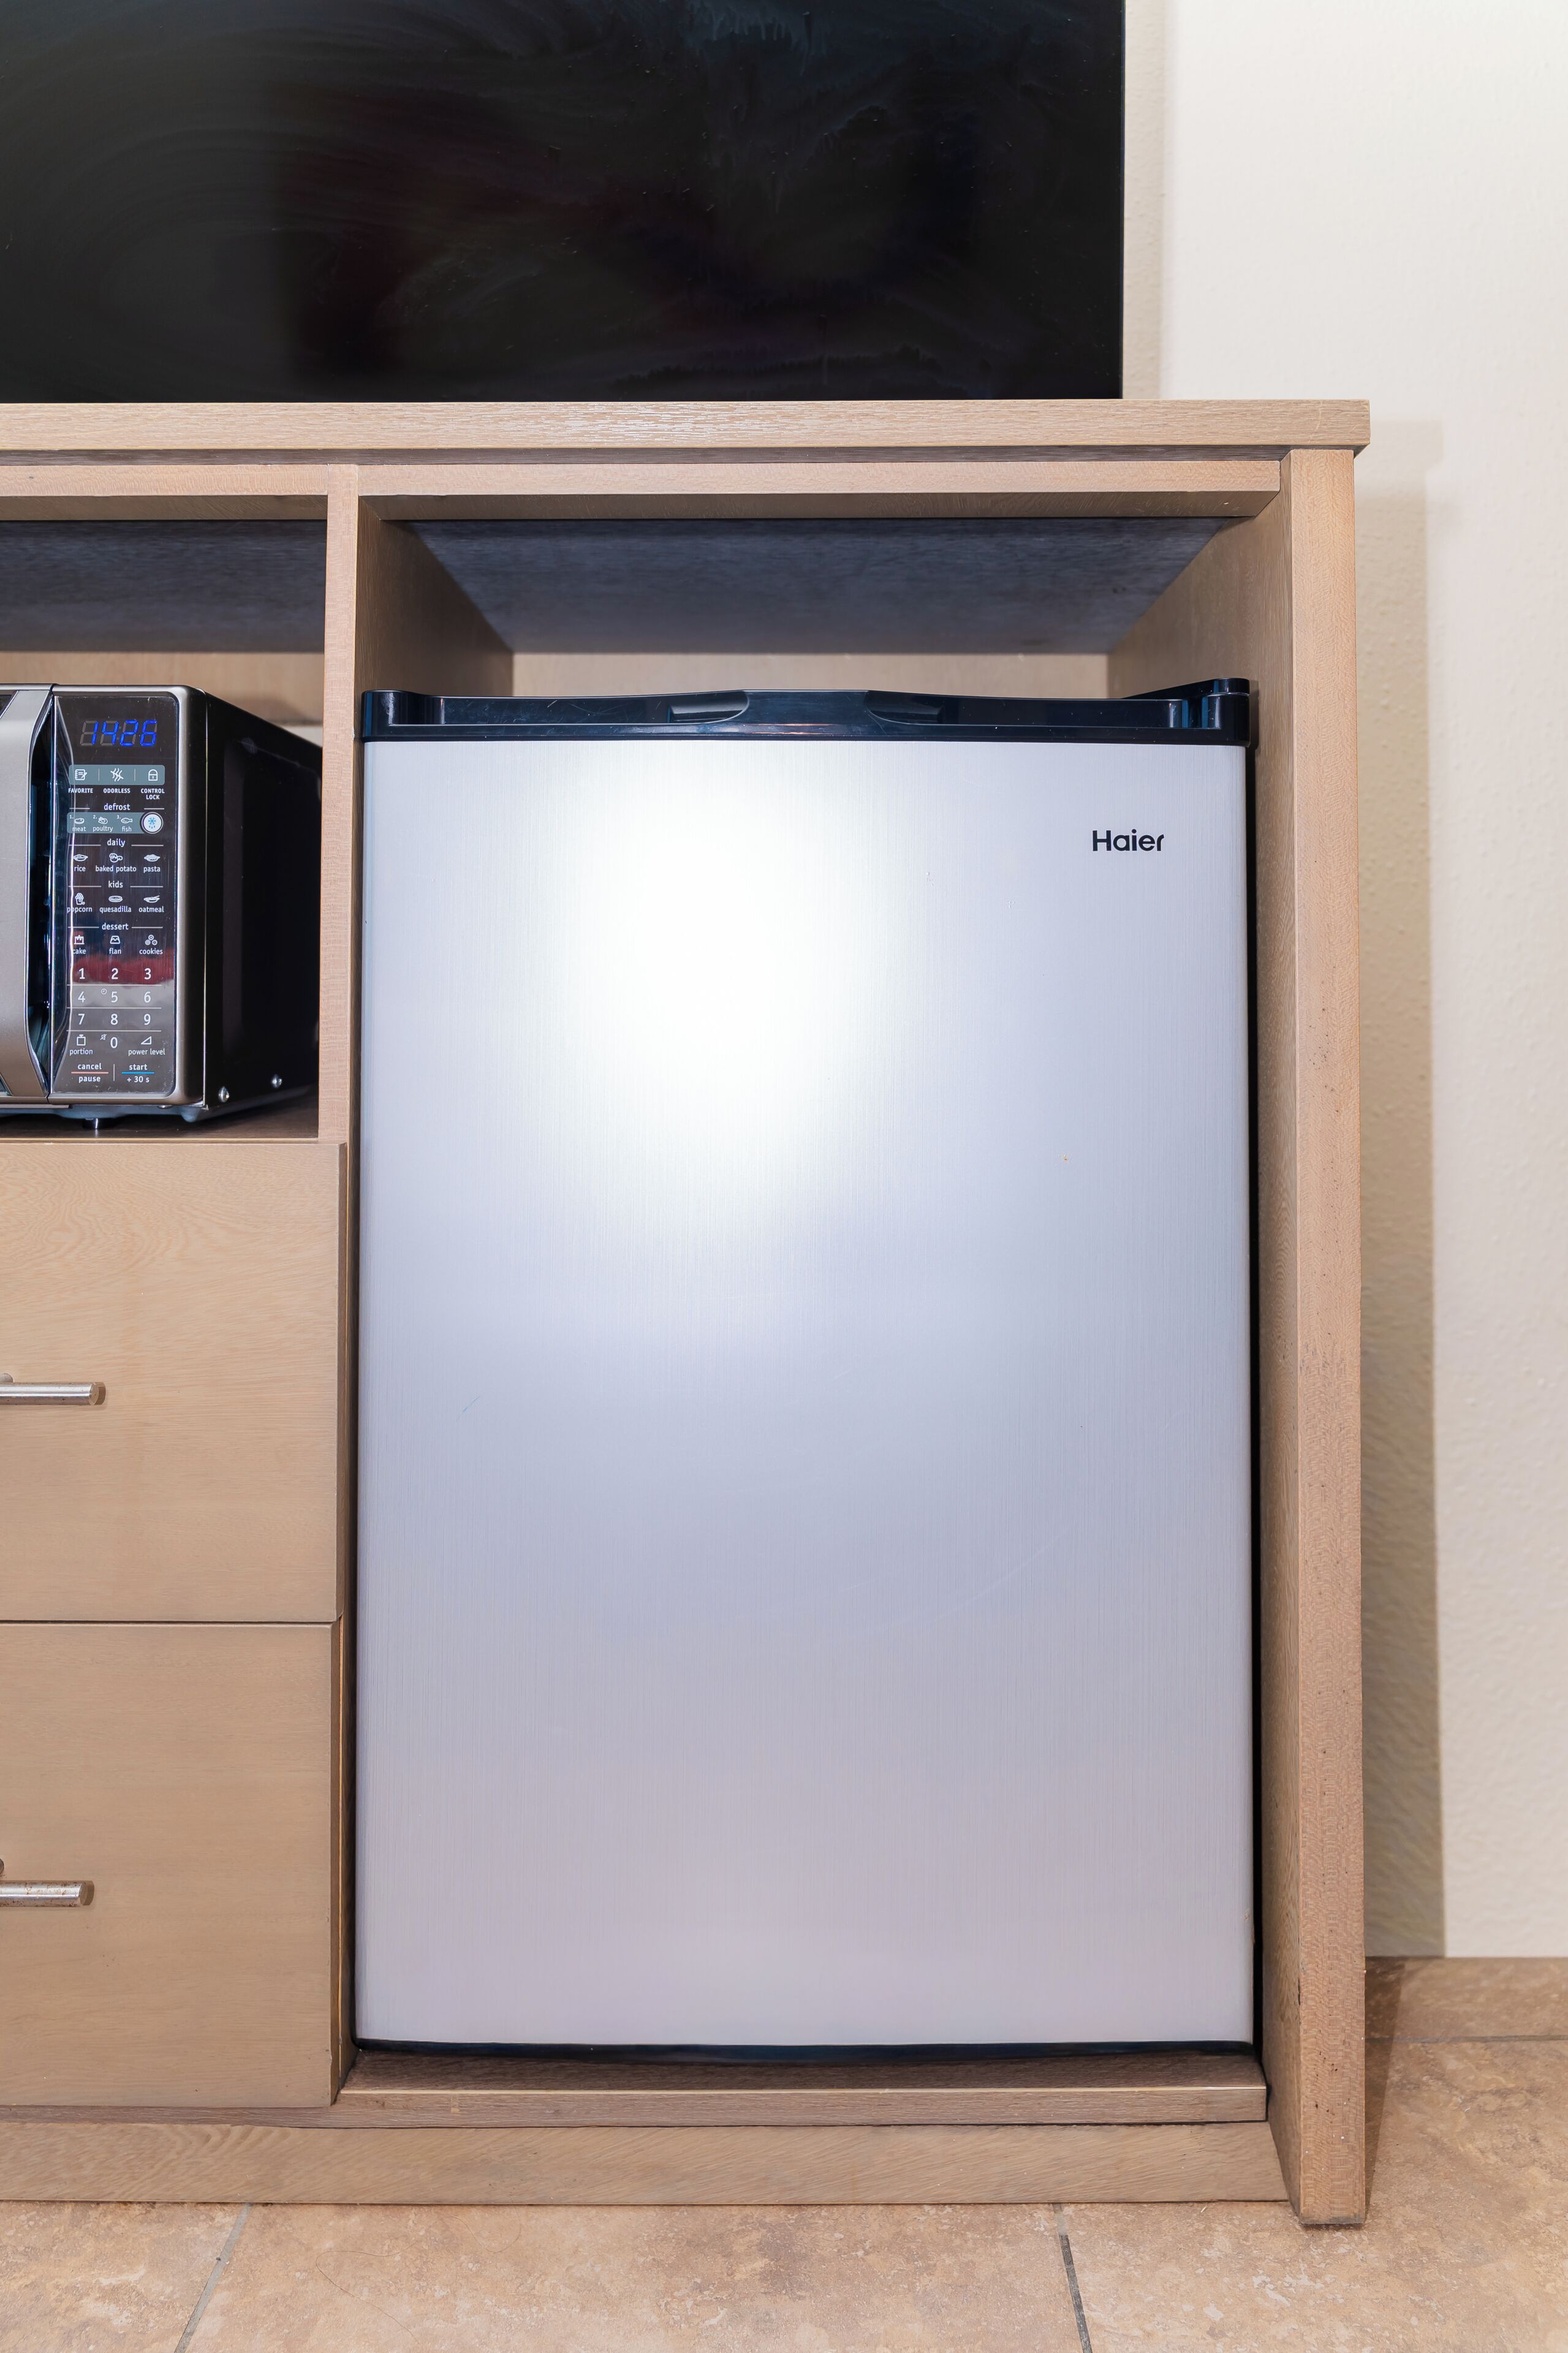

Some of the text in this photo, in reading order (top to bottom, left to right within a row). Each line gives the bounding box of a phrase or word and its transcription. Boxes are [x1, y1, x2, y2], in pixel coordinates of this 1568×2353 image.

[107, 838, 126, 847] daily
[1093, 828, 1165, 852] Haier
[78, 968, 85, 979] 1
[112, 968, 118, 980] 2
[144, 968, 151, 980] 3
[78, 991, 85, 1002] 4
[111, 991, 118, 1002] 5
[144, 991, 151, 1002] 6
[78, 1014, 85, 1025] 7
[111, 1014, 118, 1025] 8
[144, 1014, 151, 1025] 9
[110, 1037, 118, 1048] 0
